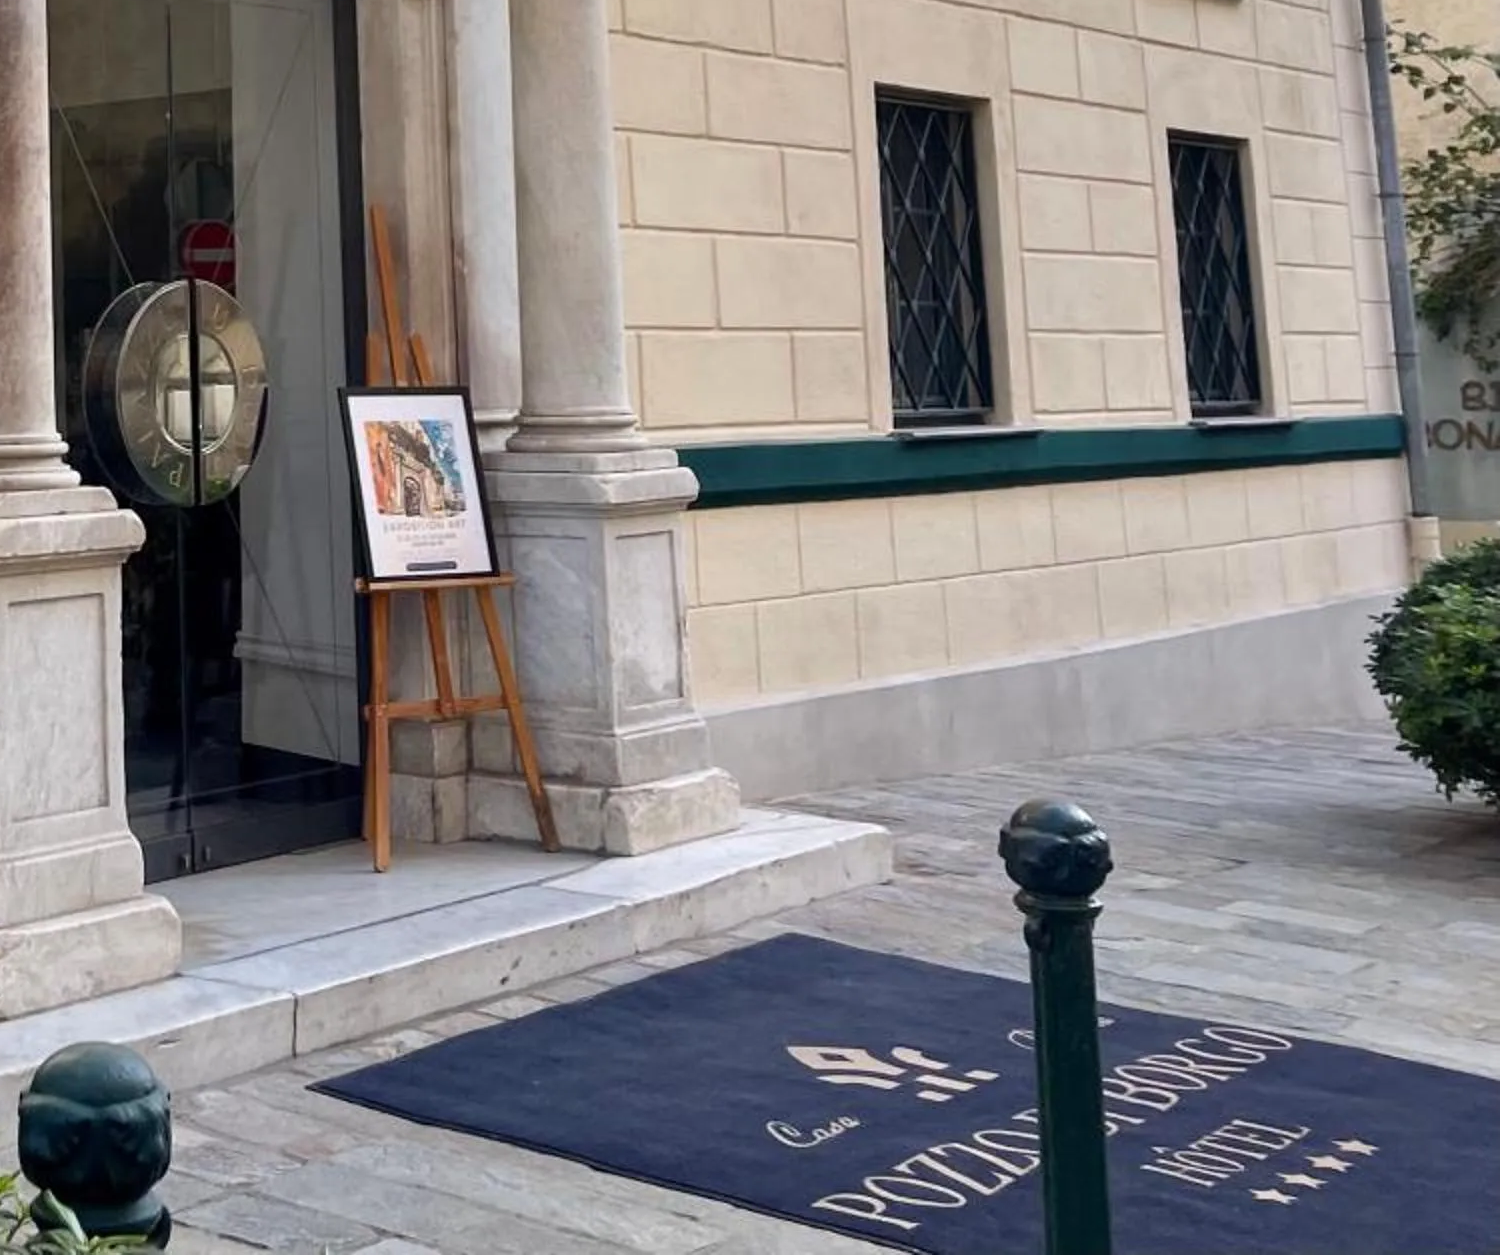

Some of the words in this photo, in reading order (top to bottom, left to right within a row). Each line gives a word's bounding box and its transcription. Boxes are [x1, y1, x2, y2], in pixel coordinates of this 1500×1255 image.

[765, 1114, 861, 1148] Casa
[811, 1129, 1041, 1230] POZZO
[1101, 1026, 1292, 1111] BORGO
[1140, 1118, 1312, 1187] HÔTEL
